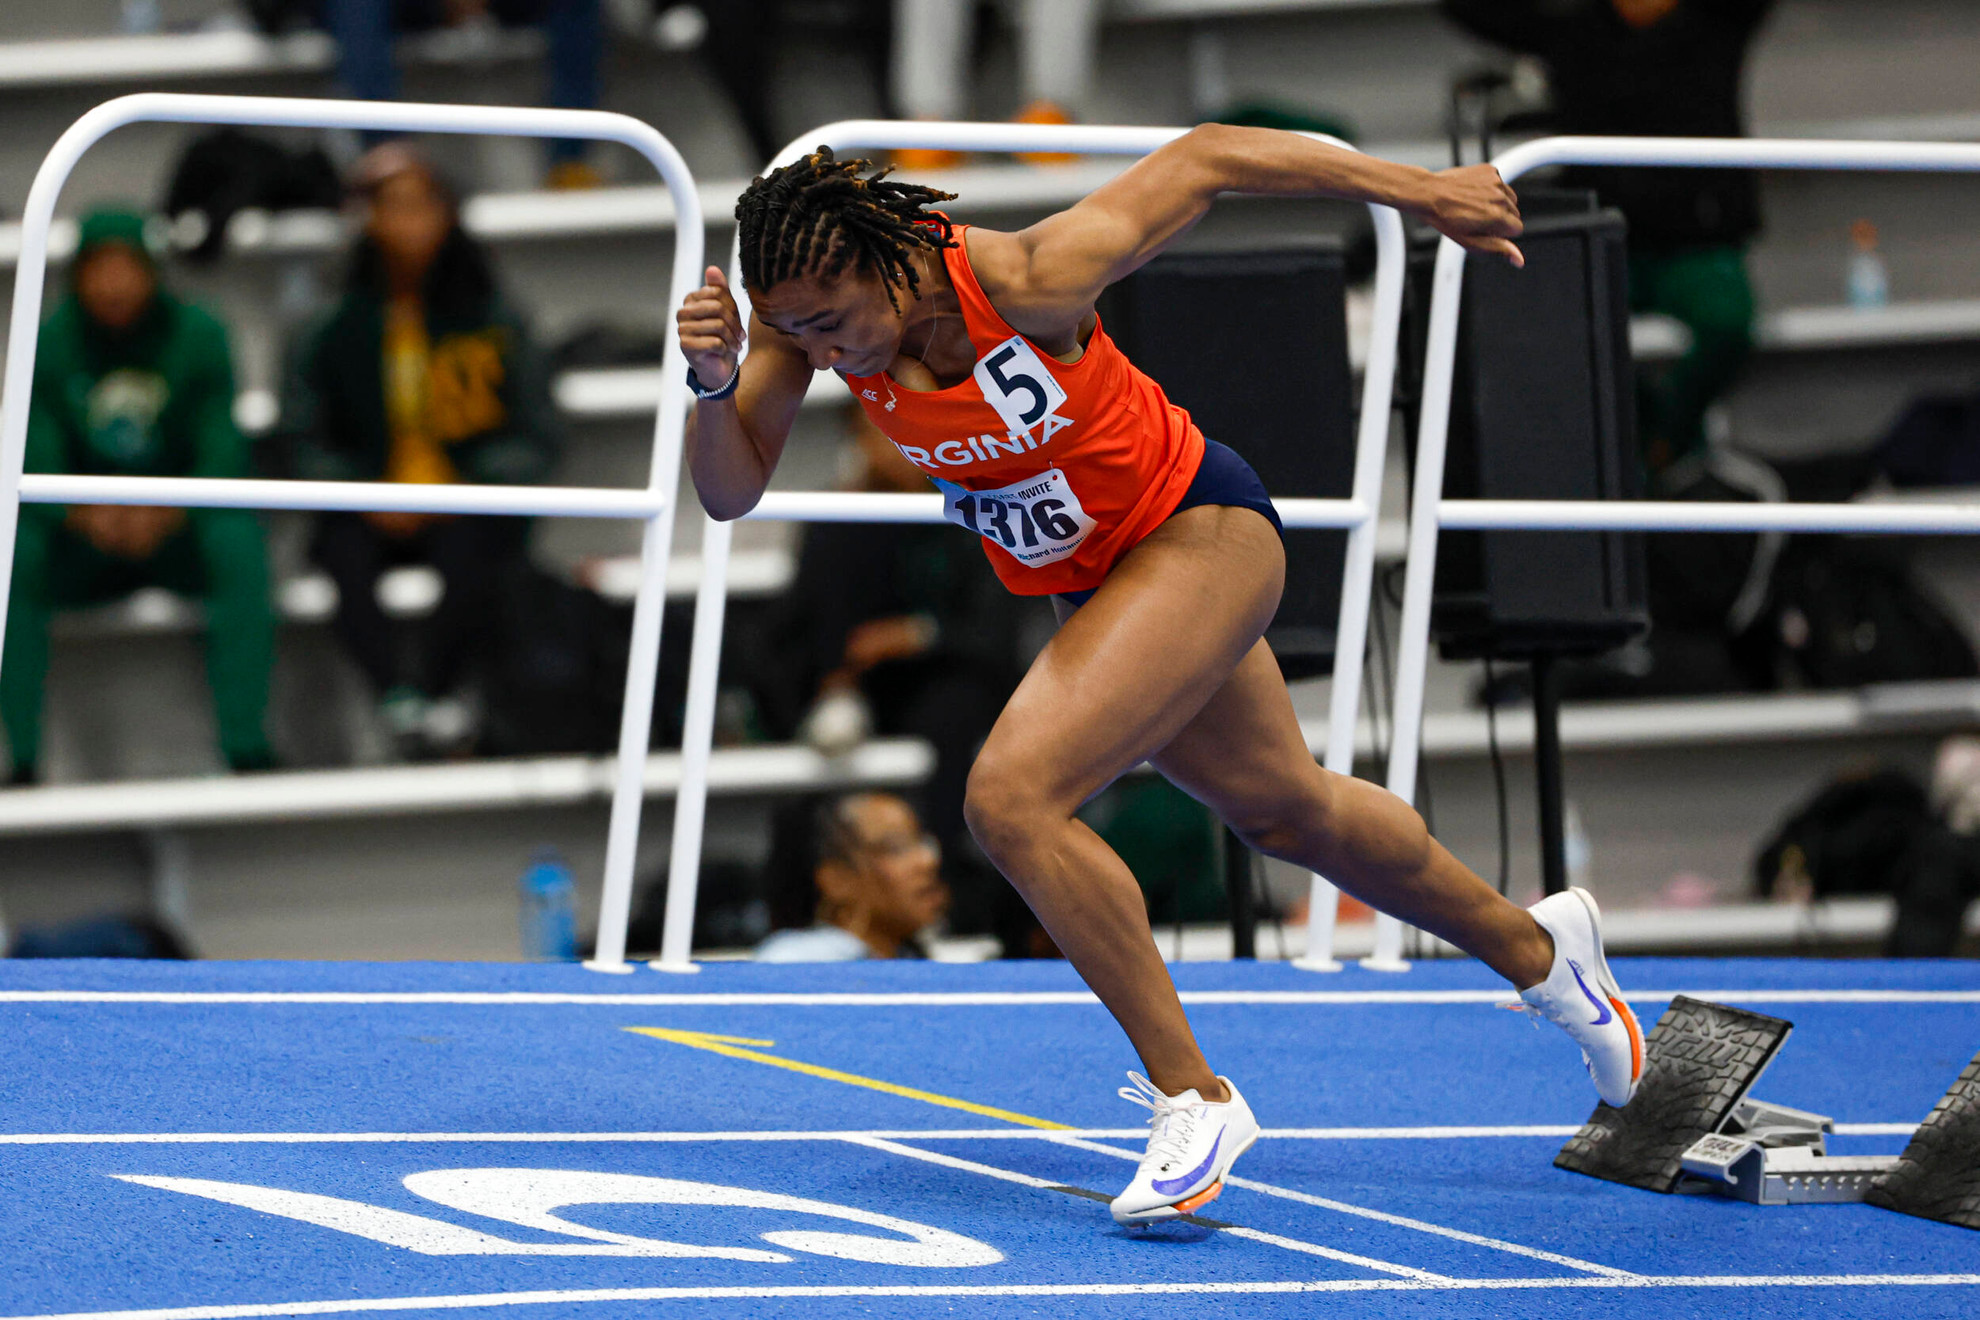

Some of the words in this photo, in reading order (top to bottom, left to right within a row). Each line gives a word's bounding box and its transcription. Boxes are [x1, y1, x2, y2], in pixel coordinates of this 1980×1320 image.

[984, 345, 1048, 426] 5
[888, 412, 1076, 469] RGINIA
[1018, 481, 1053, 501] INVITE
[954, 494, 1080, 548] 1376
[107, 1167, 1005, 1269] 5
